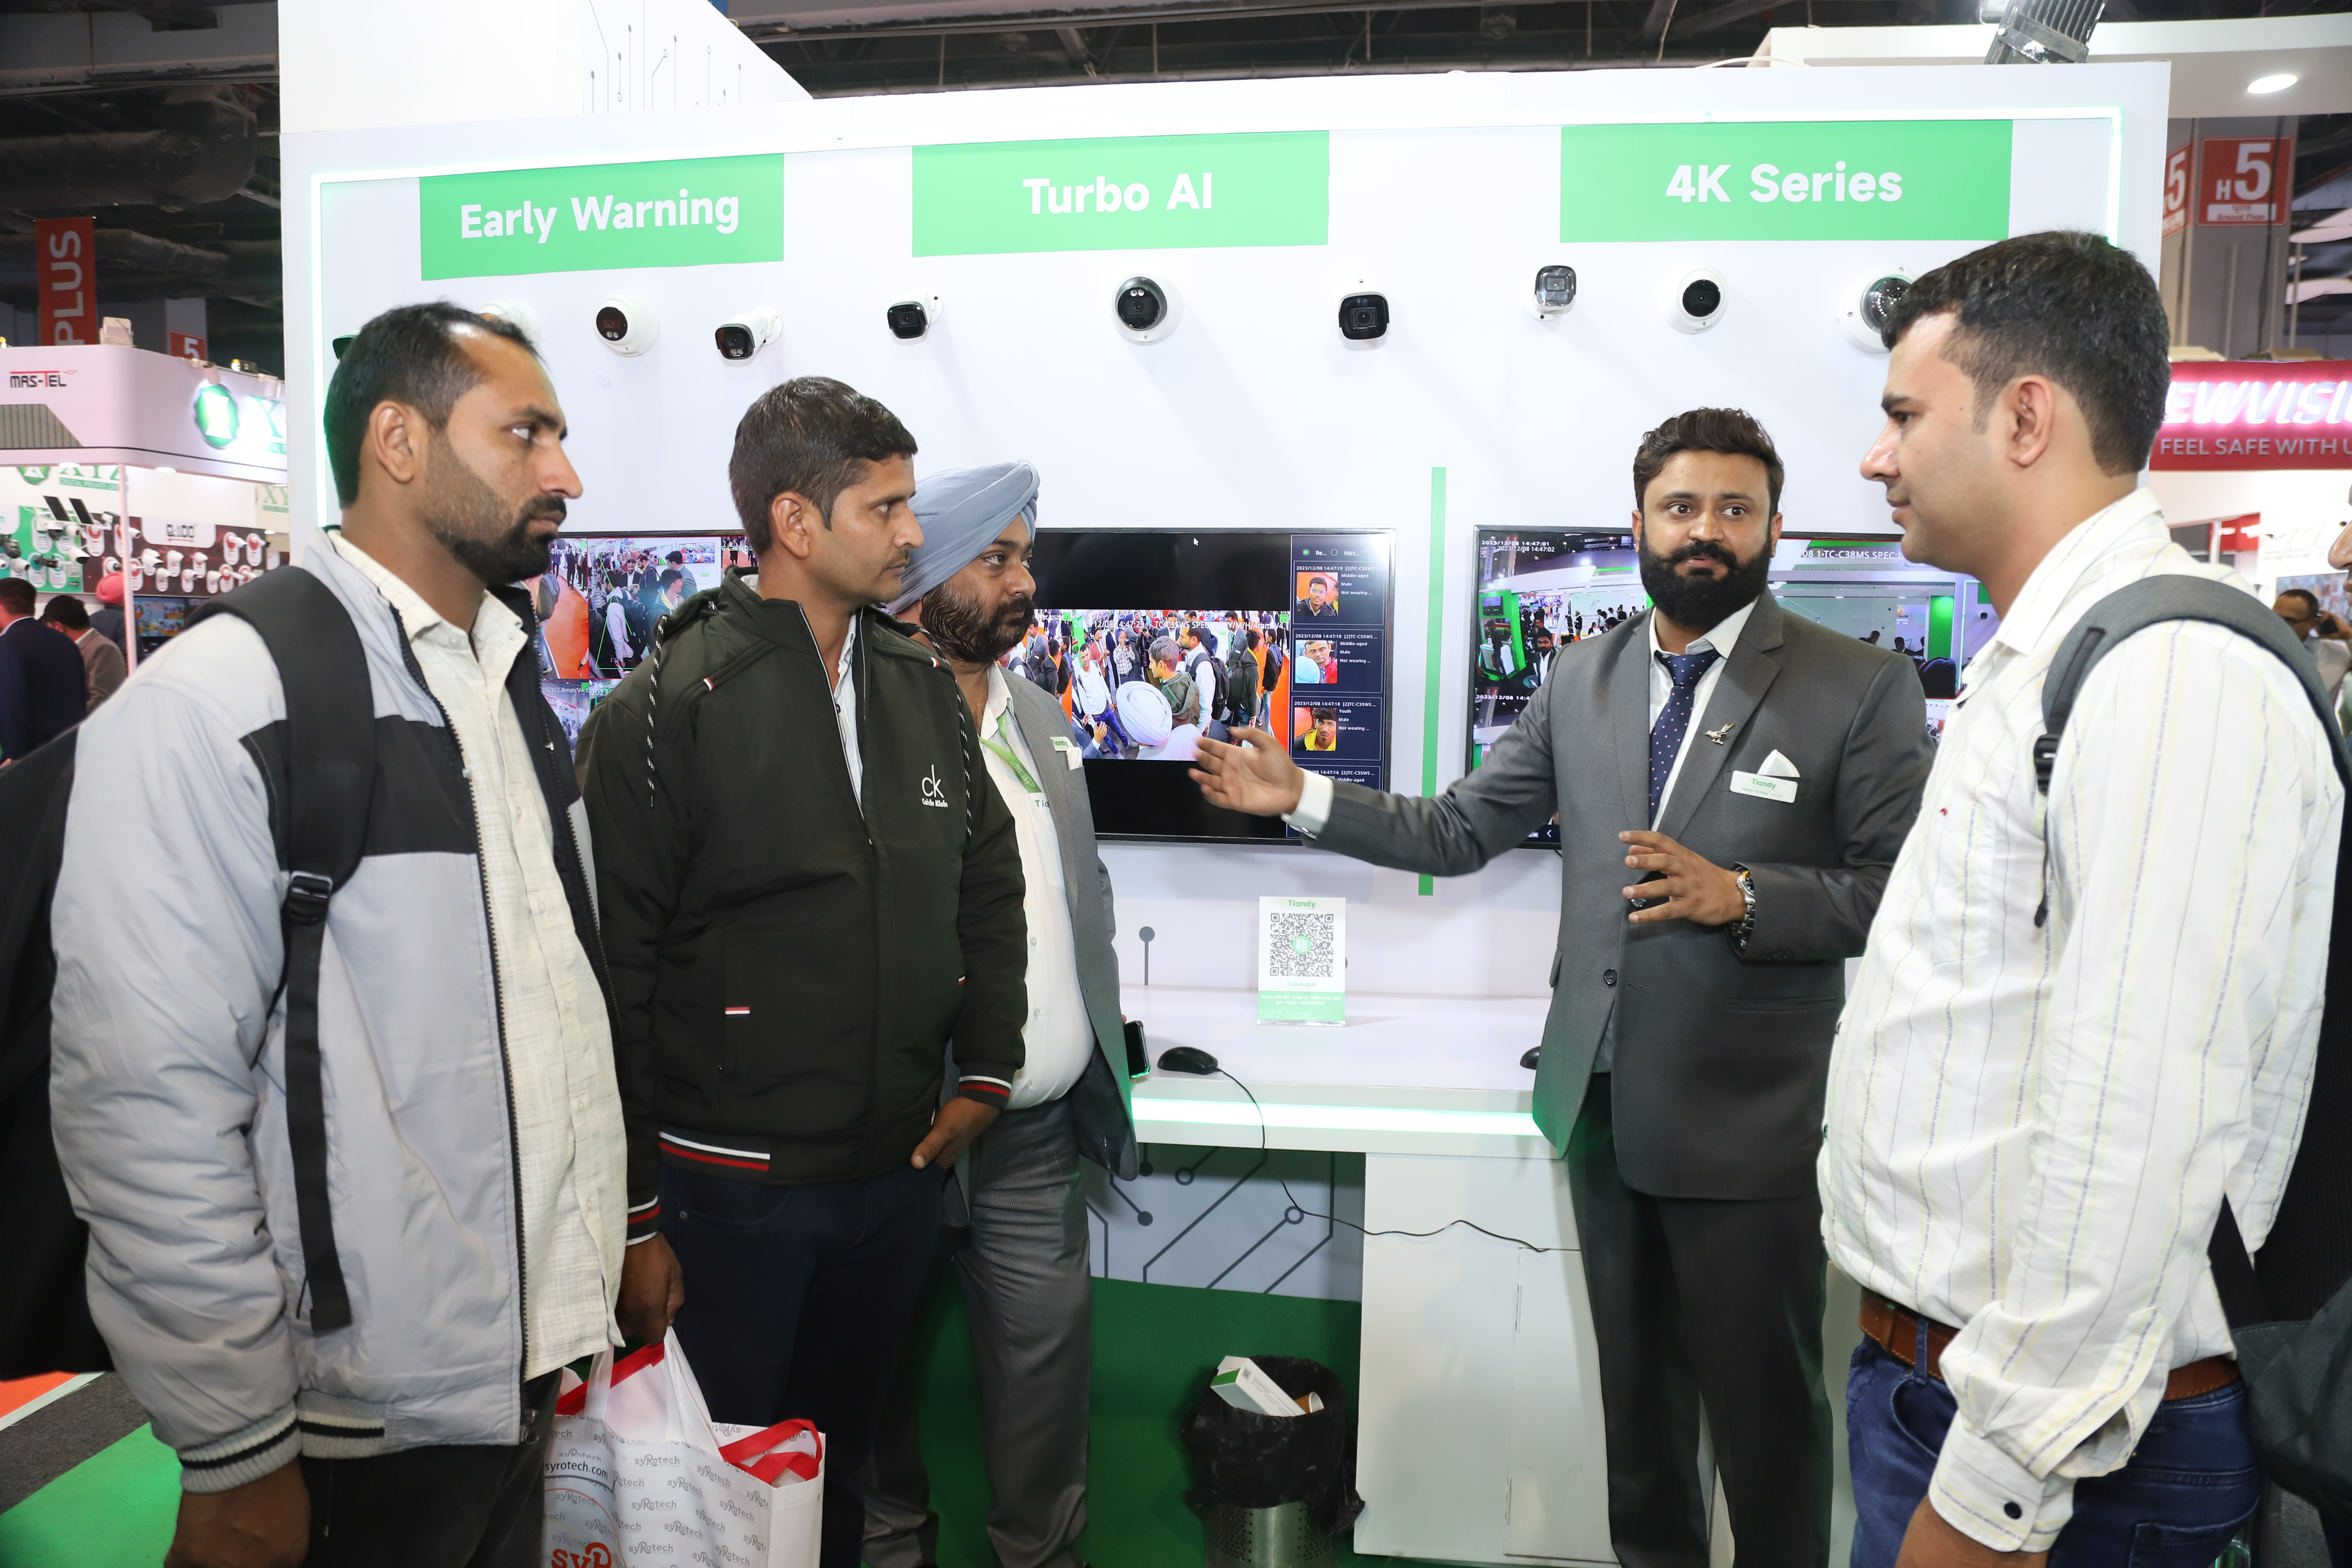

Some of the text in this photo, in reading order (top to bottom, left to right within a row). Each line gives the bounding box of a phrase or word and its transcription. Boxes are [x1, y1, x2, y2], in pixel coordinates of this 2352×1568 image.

[1666, 161, 1902, 203] 4K Series
[1023, 173, 1212, 214] Turbo AI
[461, 189, 739, 243] Early Warning
[50, 230, 84, 345] PLUS
[184, 337, 198, 359] 5
[2162, 381, 2352, 424] EWVISI
[2161, 438, 2210, 455] FEEL
[2216, 438, 2271, 455] SAFE
[2275, 438, 2338, 455] WITH
[1824, 550, 1870, 559] TC-C38MS
[1752, 778, 1777, 790] Tiandy
[935, 799, 948, 808] Klein
[1288, 900, 1316, 909] Tiandy
[634, 1454, 680, 1467] syRotech
[545, 1461, 608, 1480] syrotech.com
[697, 1465, 730, 1487] syRotech
[667, 1476, 703, 1498] syRotech
[631, 1498, 677, 1511] syRotech
[747, 1491, 768, 1508] syRot
[720, 1500, 754, 1522] syRotech
[664, 1521, 703, 1539] syRotech
[629, 1542, 674, 1554] syRotech
[744, 1534, 766, 1551] syRot
[716, 1545, 750, 1567] syRotech
